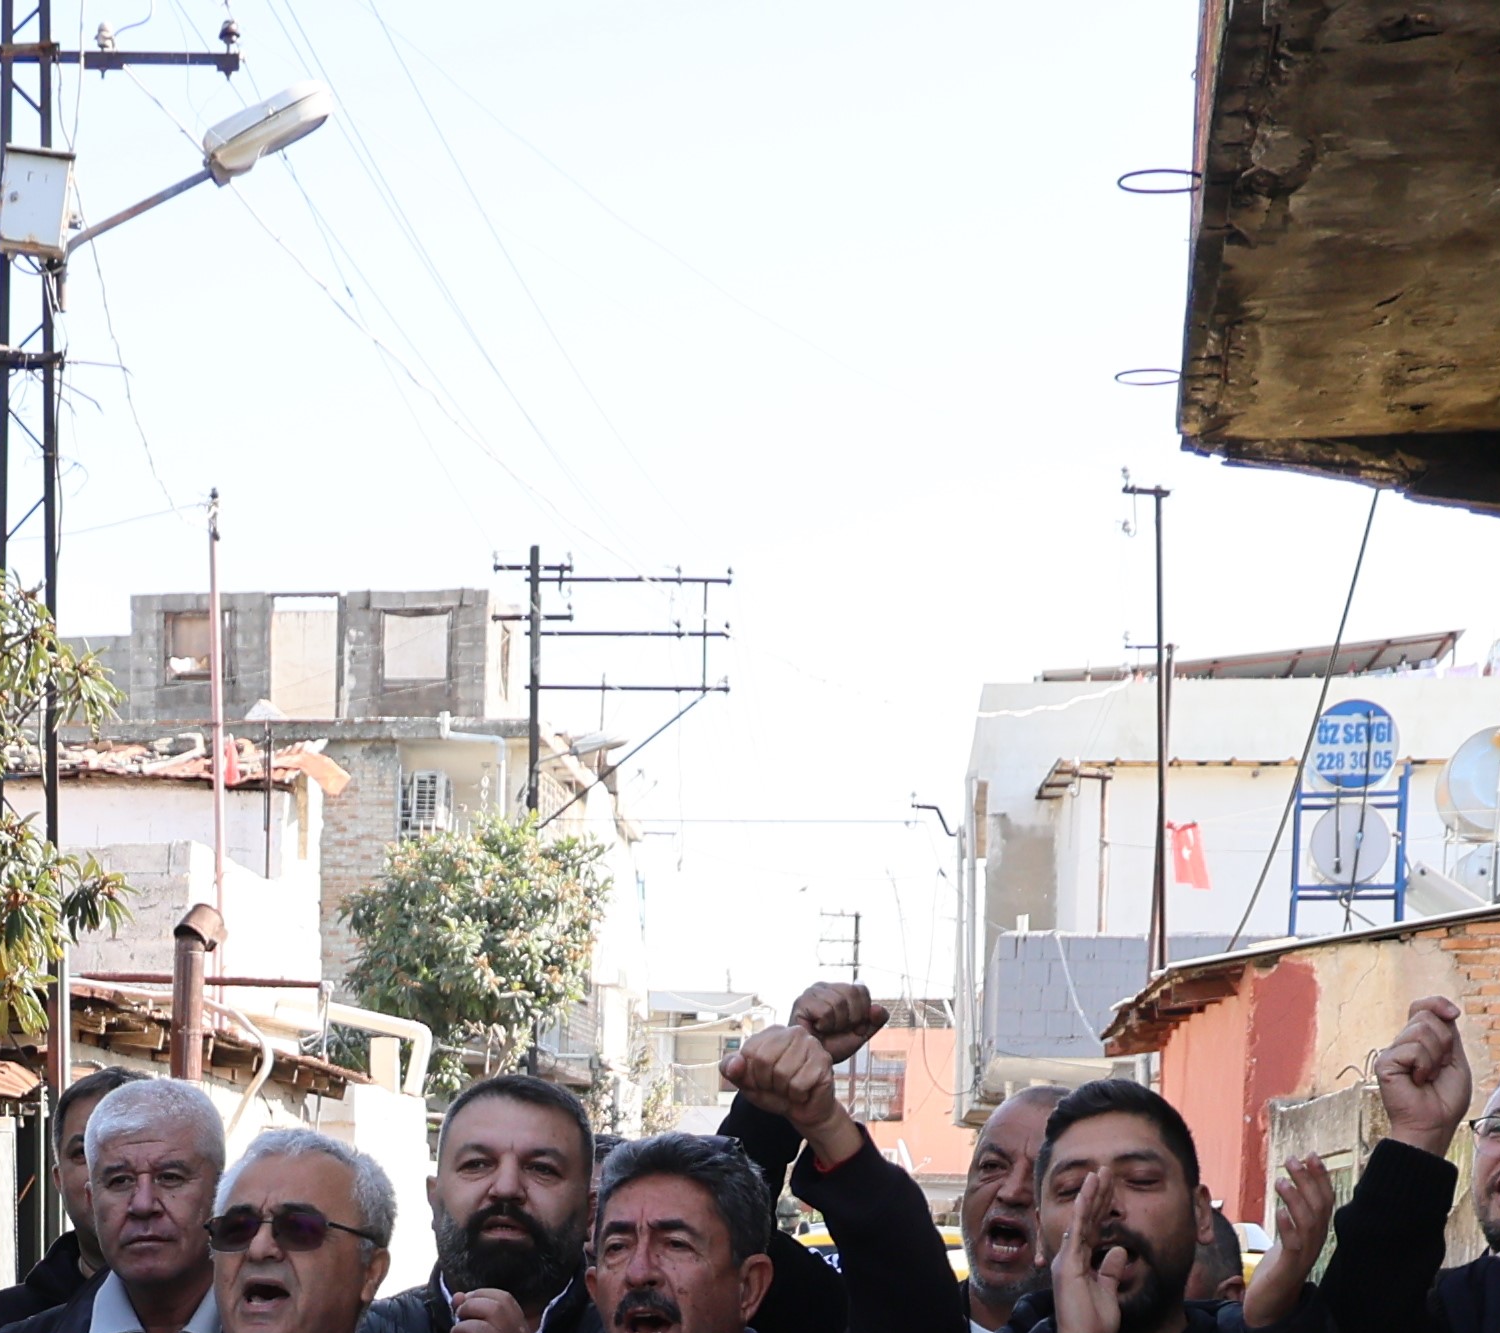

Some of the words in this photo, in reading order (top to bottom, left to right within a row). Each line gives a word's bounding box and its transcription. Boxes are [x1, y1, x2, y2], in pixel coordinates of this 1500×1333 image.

[1317, 718, 1340, 745] ÖZ
[1317, 751, 1345, 771] 228
[1350, 751, 1368, 769] 30
[1373, 749, 1393, 769] 05
